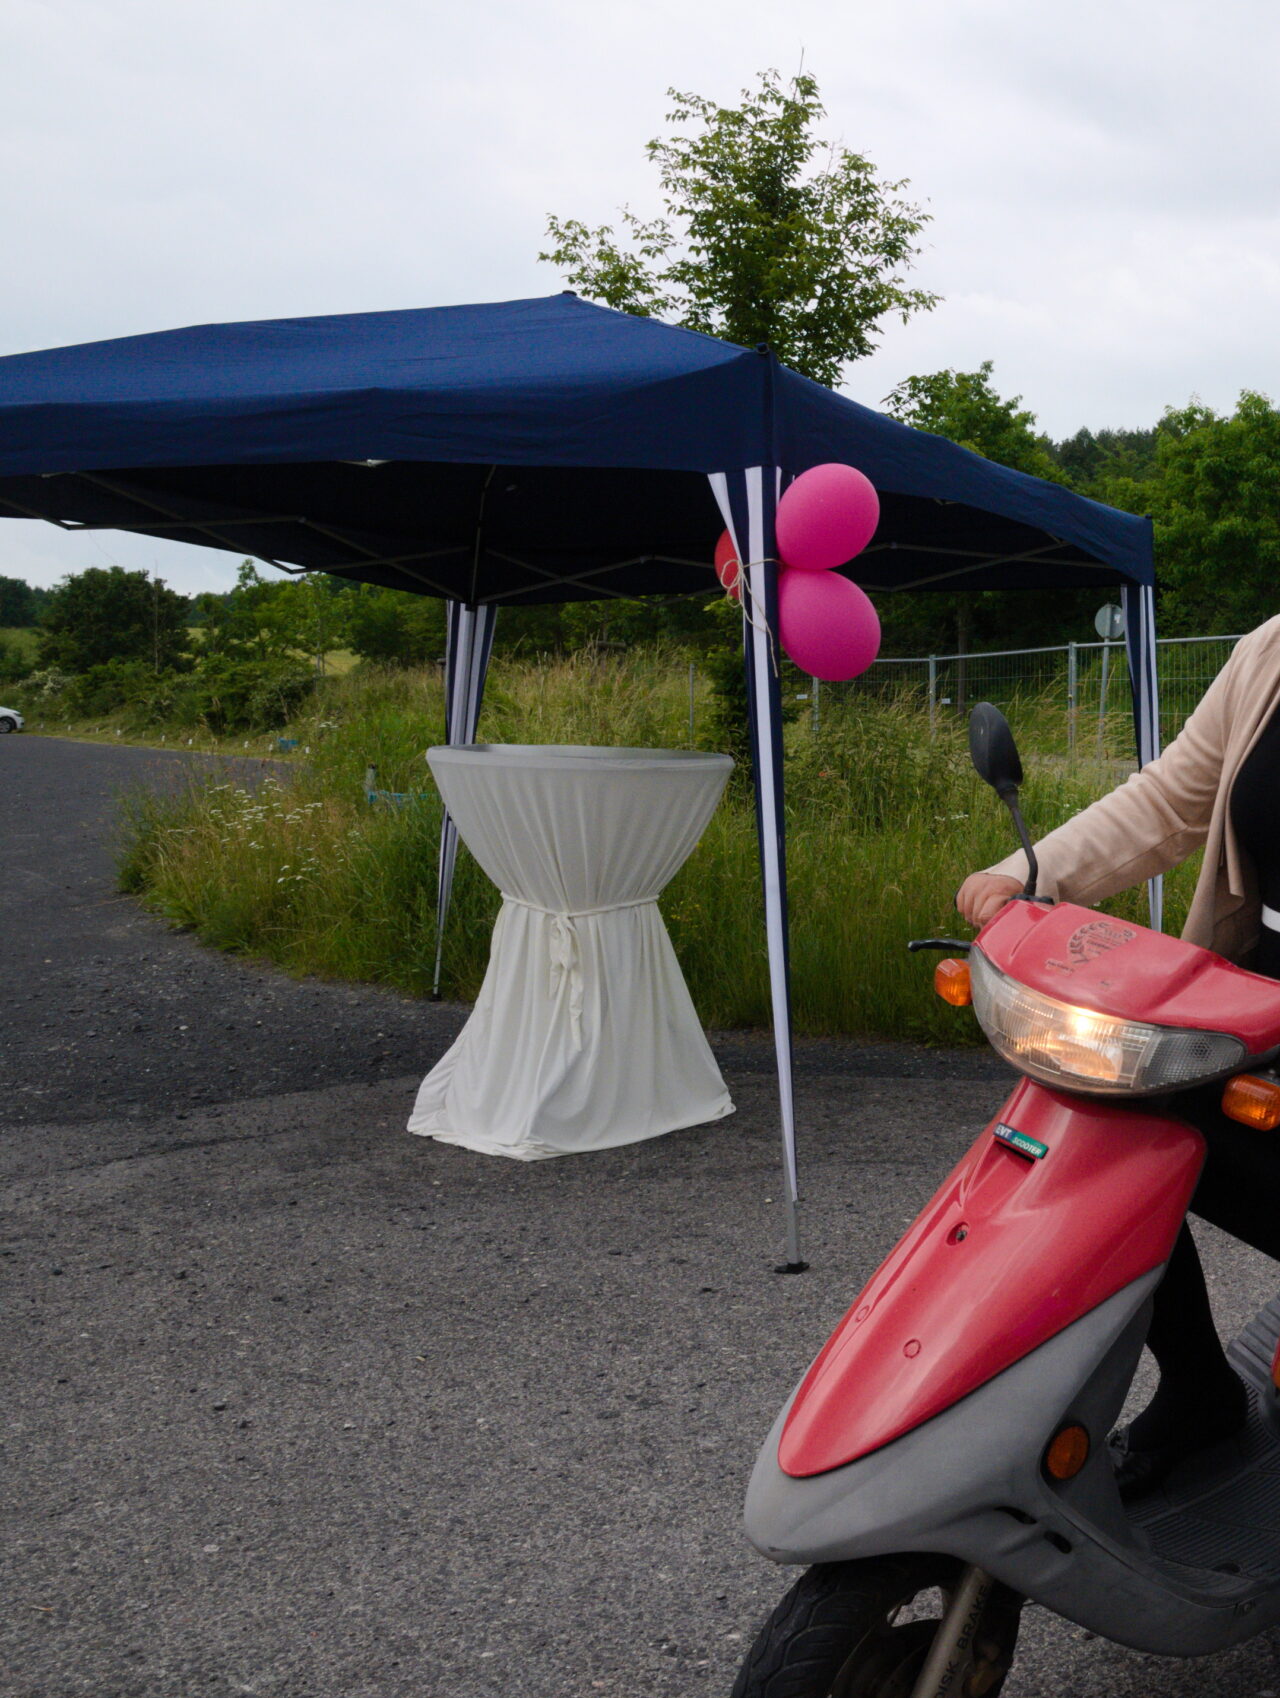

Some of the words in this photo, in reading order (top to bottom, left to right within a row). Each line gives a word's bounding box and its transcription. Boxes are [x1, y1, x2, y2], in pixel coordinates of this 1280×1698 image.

[994, 1123, 1013, 1139] EVT
[1011, 1136, 1043, 1157] SCOOTER
[956, 1584, 991, 1649] BRAKE
